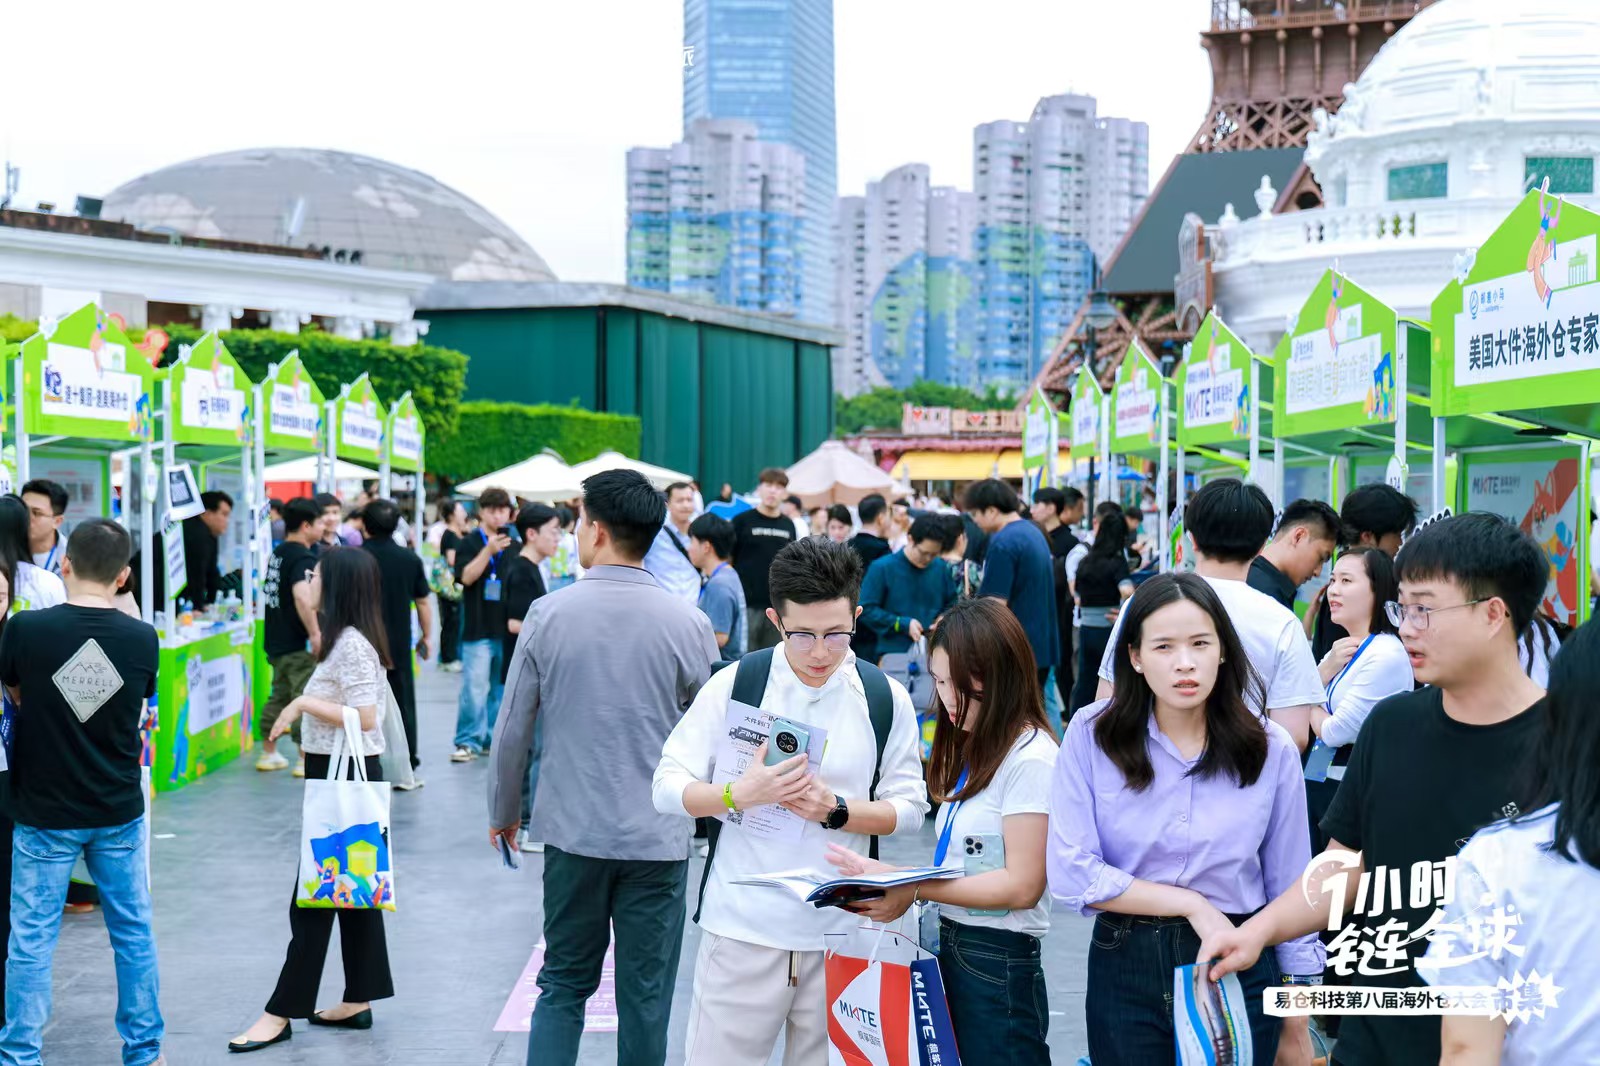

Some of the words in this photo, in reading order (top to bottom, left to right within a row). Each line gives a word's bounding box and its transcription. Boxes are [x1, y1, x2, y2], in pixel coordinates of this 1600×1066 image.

[1469, 312, 1599, 371] 美国大件海外仓专家
[62, 675, 113, 687] MERRELL
